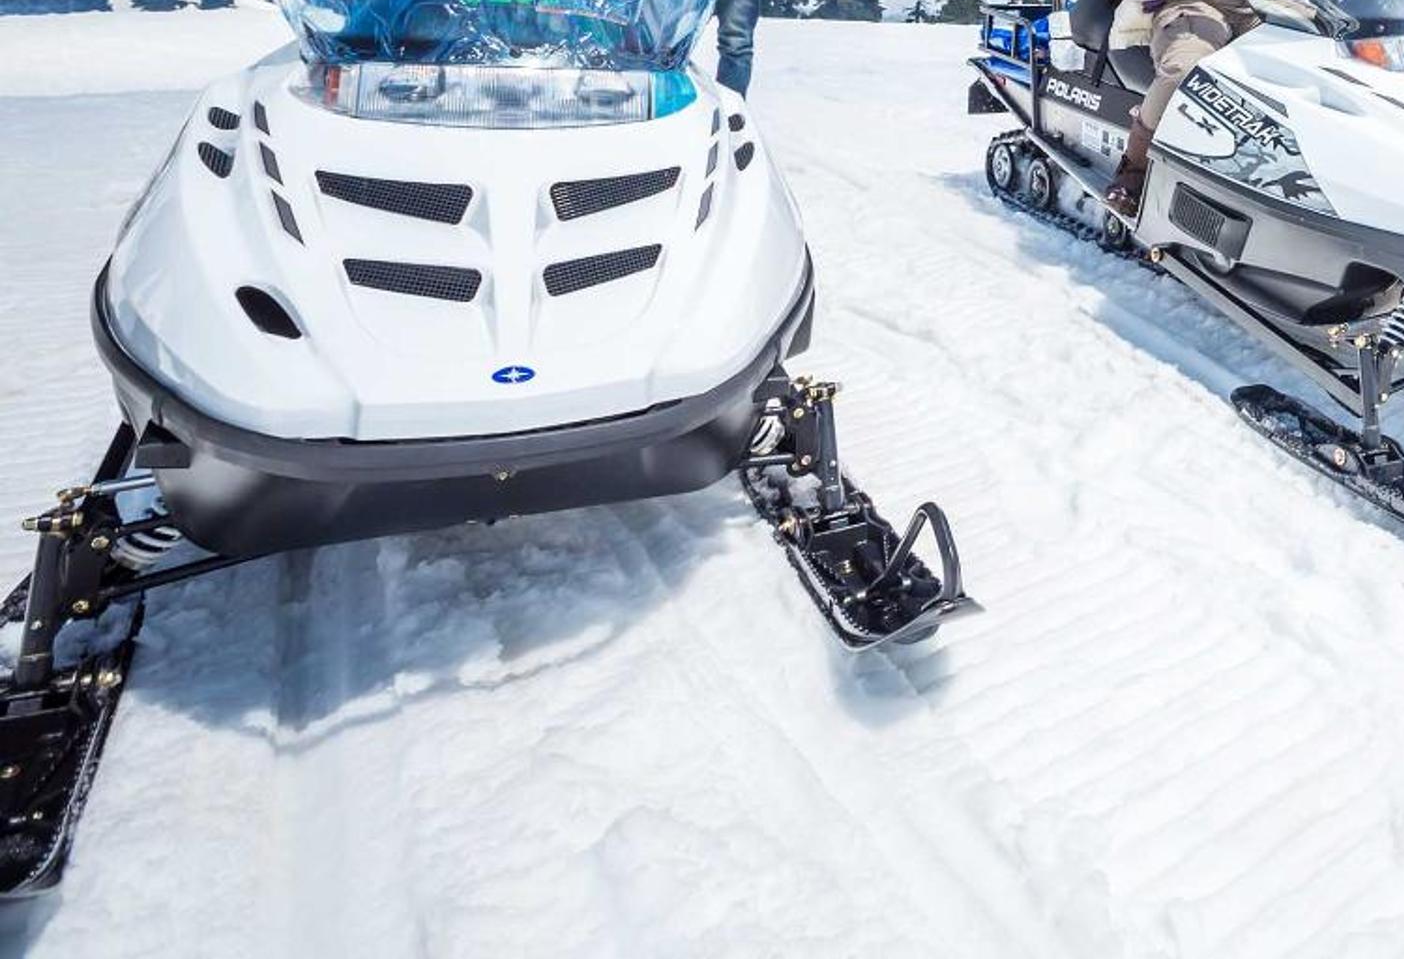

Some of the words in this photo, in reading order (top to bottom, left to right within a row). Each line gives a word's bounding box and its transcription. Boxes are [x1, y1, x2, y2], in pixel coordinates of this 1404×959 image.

[1046, 78, 1102, 111] POLARIS
[1187, 74, 1279, 144] WIDETRAK
[1178, 103, 1219, 136] LX
